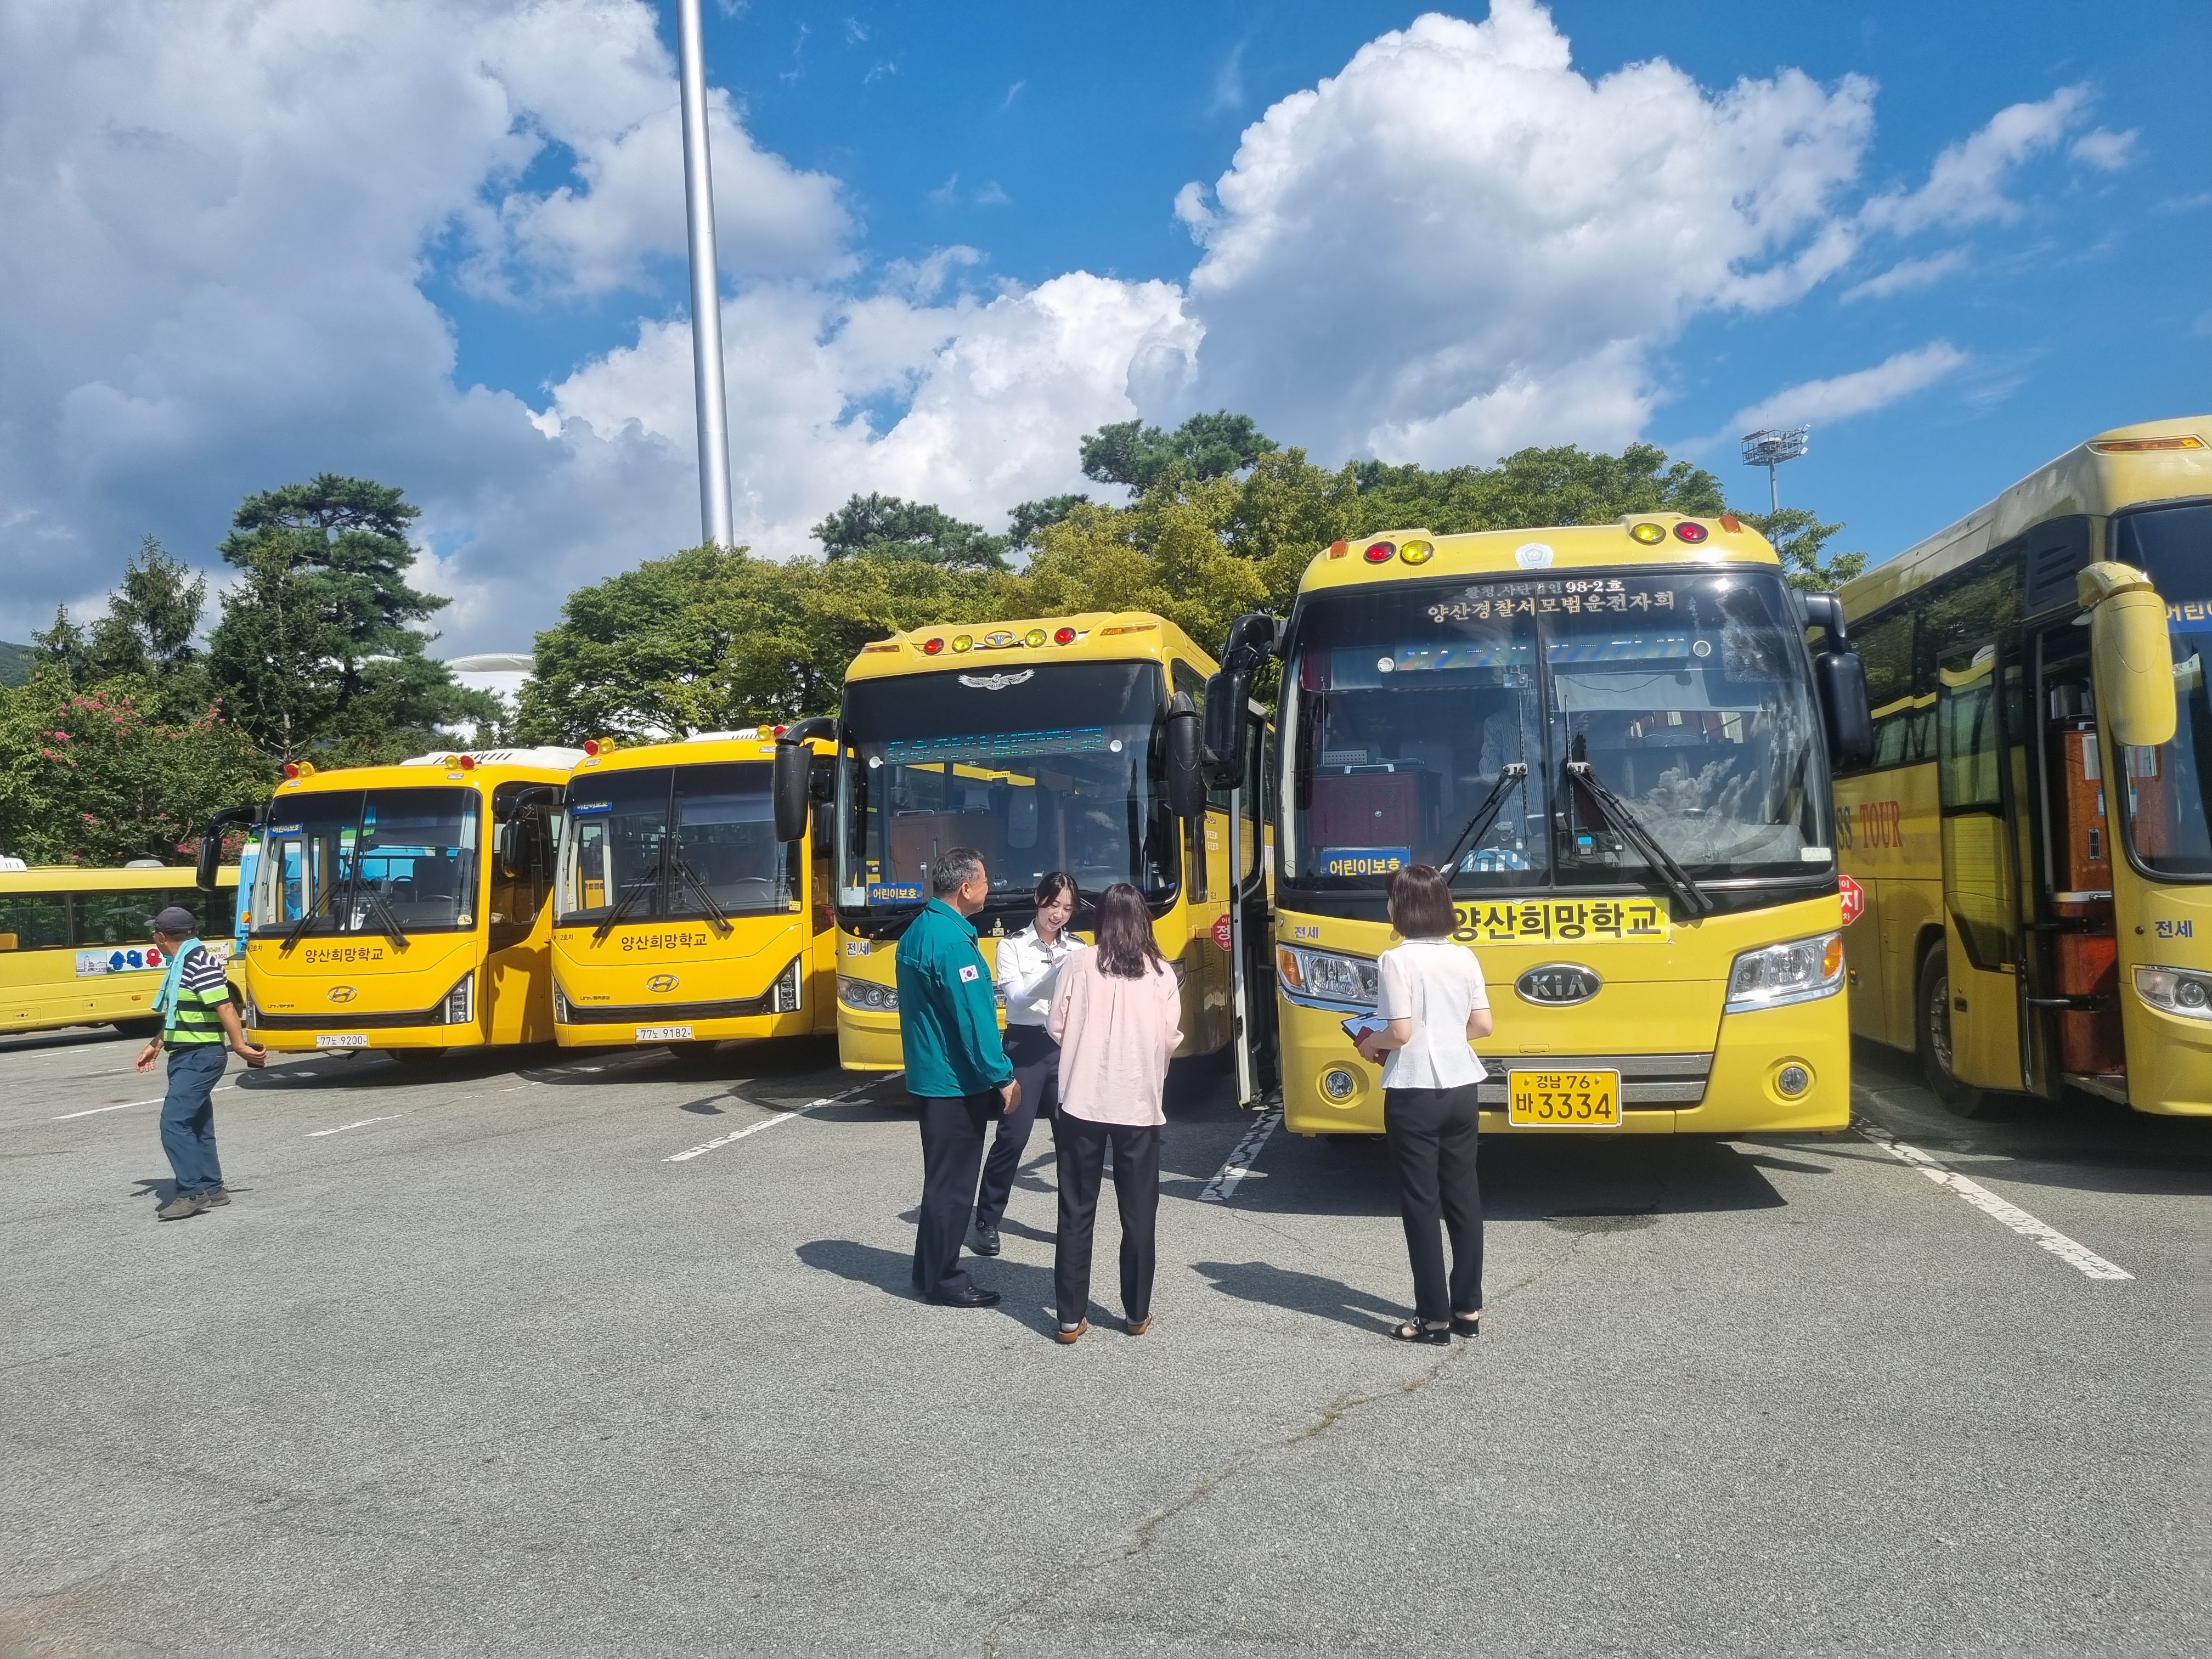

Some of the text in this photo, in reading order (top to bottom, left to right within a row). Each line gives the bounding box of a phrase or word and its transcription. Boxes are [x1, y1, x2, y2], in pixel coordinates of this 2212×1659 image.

[2166, 601, 2212, 622] 어린
[273, 824, 300, 833] 어린이보호
[1859, 800, 1903, 849] TOUR
[1330, 857, 1401, 876] 어린이보호
[873, 888, 917, 900] 어린이보호
[1452, 902, 1661, 942] 양산희망학교
[2155, 920, 2193, 939] 전세
[1295, 926, 1319, 939] 전세
[622, 933, 708, 951] 양산희망학교
[847, 941, 870, 956] 전세
[306, 947, 383, 963] 양산희망학교
[1530, 974, 1589, 997] KIA
[320, 1036, 363, 1046] 77노 9200
[641, 1028, 687, 1039] 77노 9182
[1536, 1075, 1590, 1089] 경남 76
